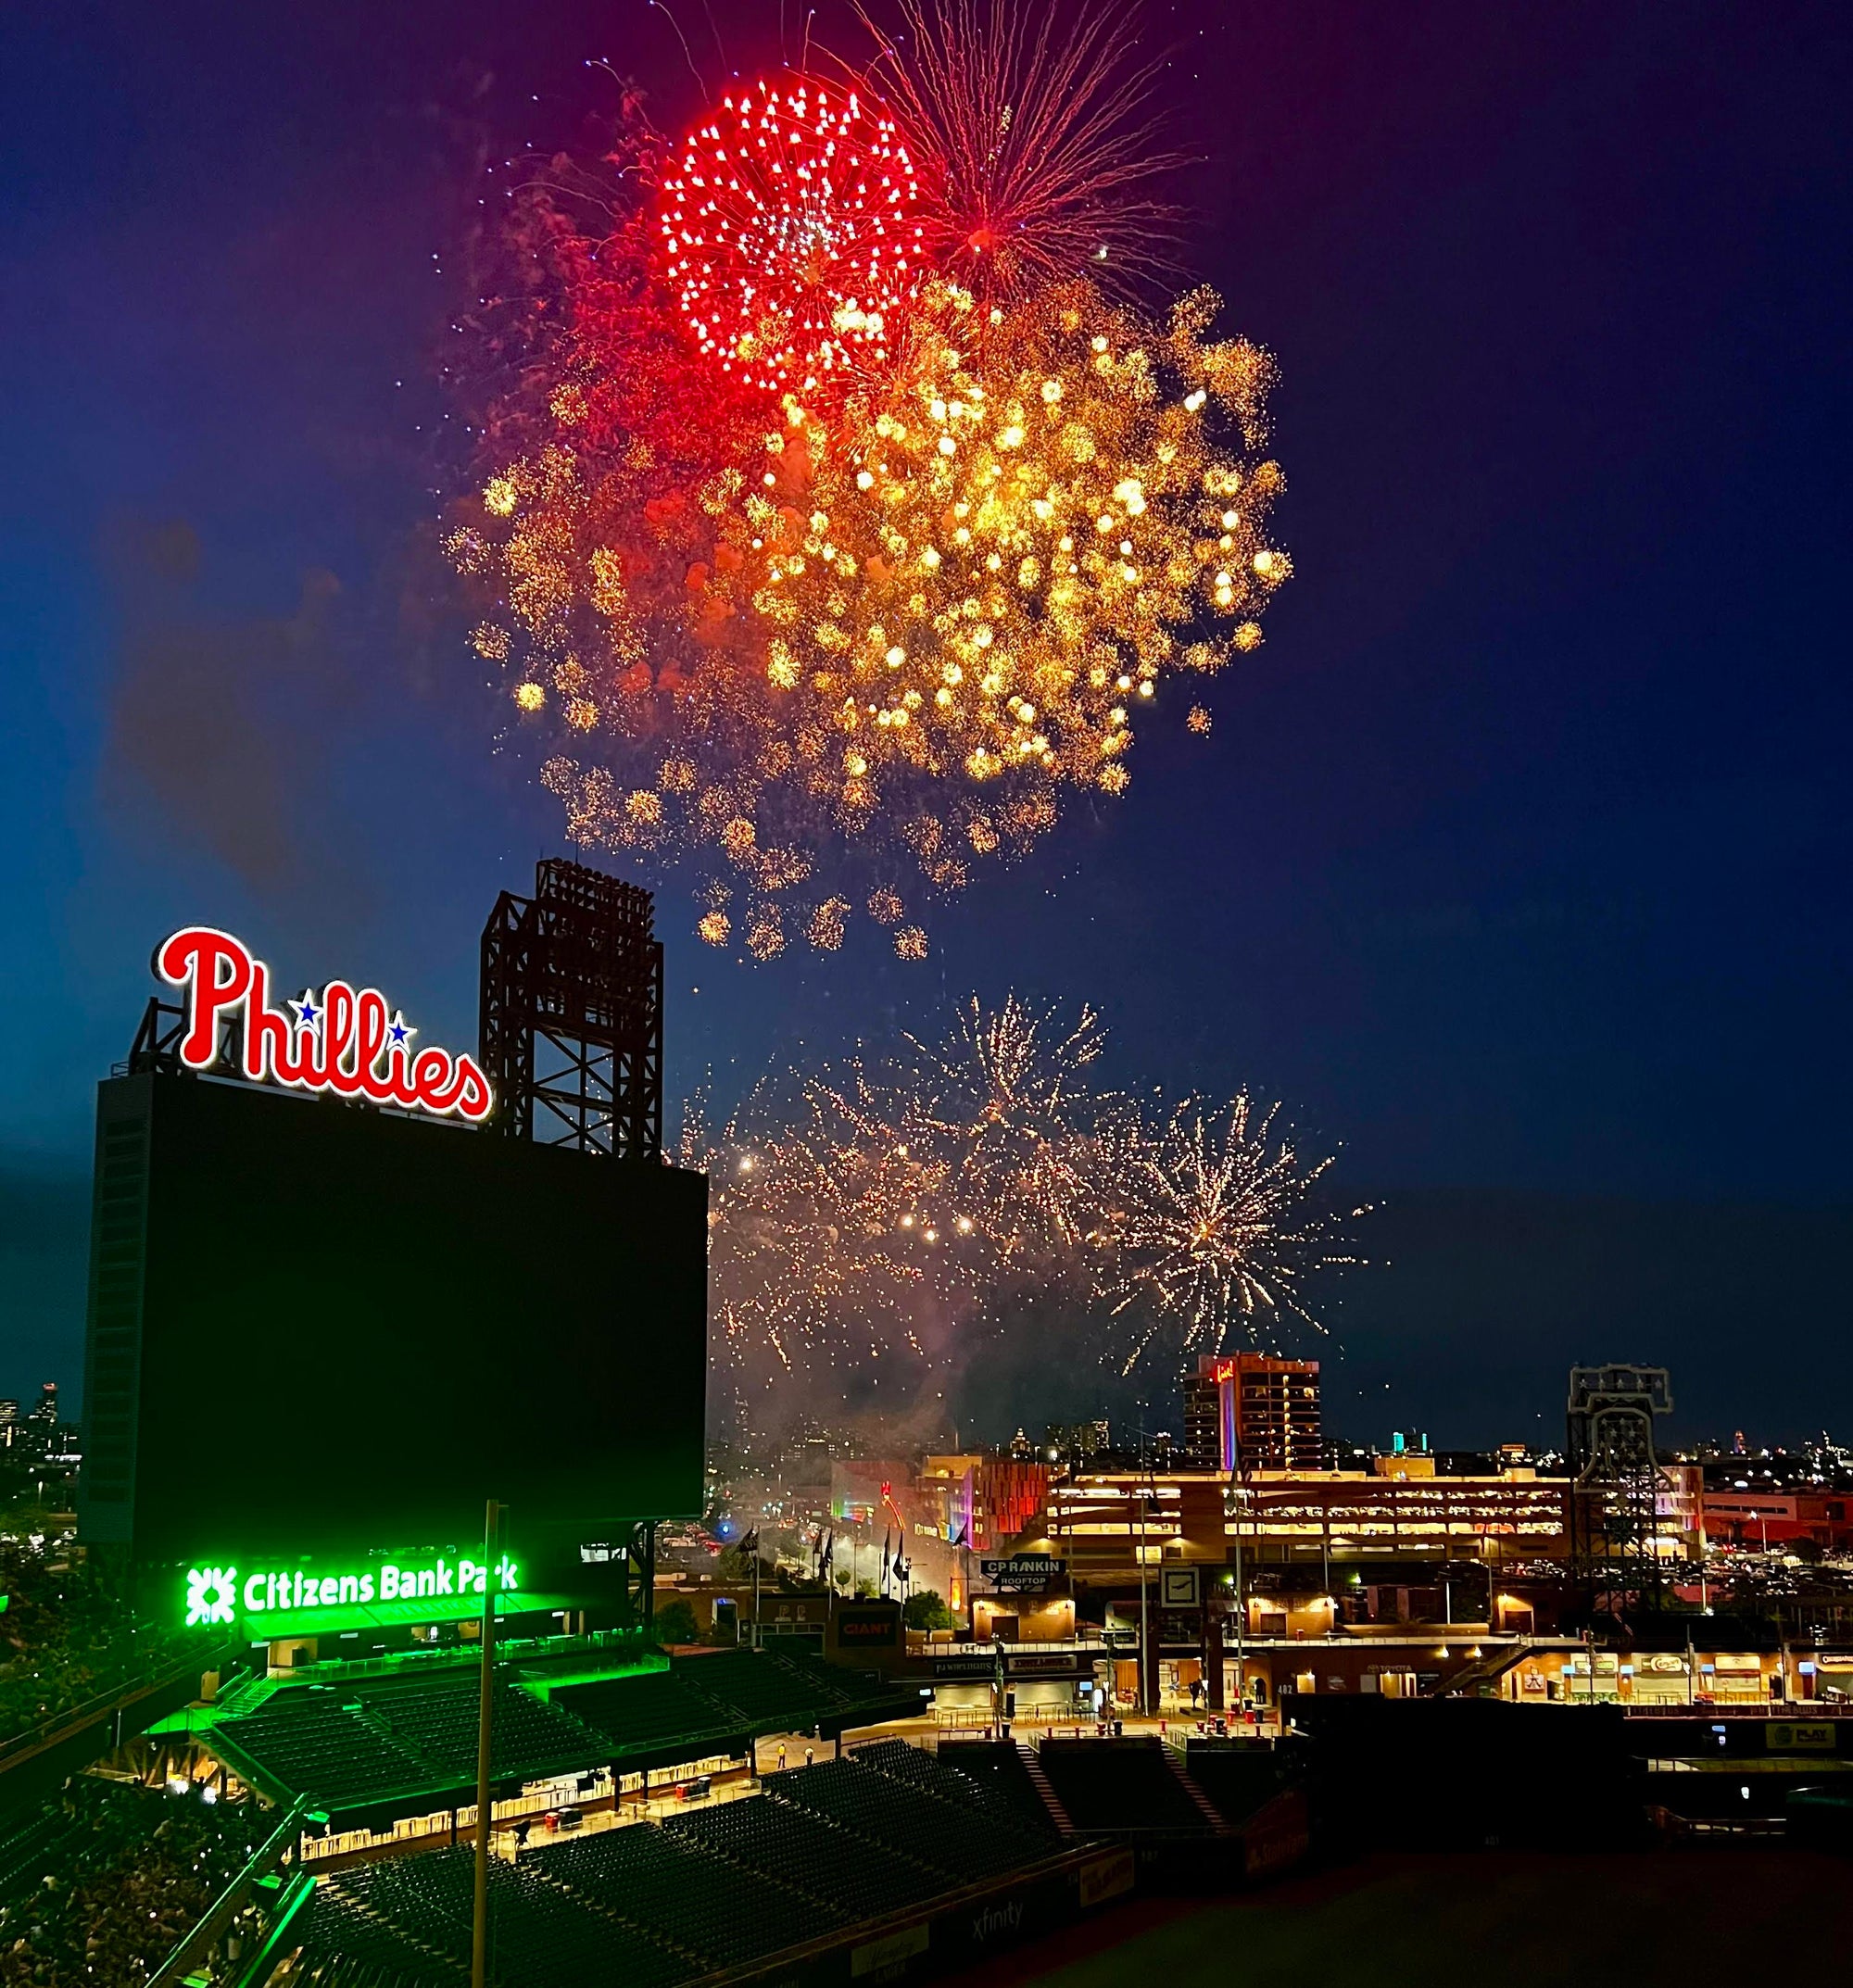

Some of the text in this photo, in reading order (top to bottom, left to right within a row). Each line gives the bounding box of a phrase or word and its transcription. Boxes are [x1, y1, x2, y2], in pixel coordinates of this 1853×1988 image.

[159, 927, 493, 1121] Phillies
[1009, 1561, 1060, 1572] RANKIN
[243, 1571, 374, 1611] Citizens
[380, 1559, 453, 1600] Bank
[458, 1554, 518, 1593] Pak
[1001, 1577, 1046, 1585] ROOFTOP
[842, 1622, 891, 1636] GIANT
[1796, 1729, 1827, 1739] PLAY
[972, 1900, 1024, 1943] xfinity
